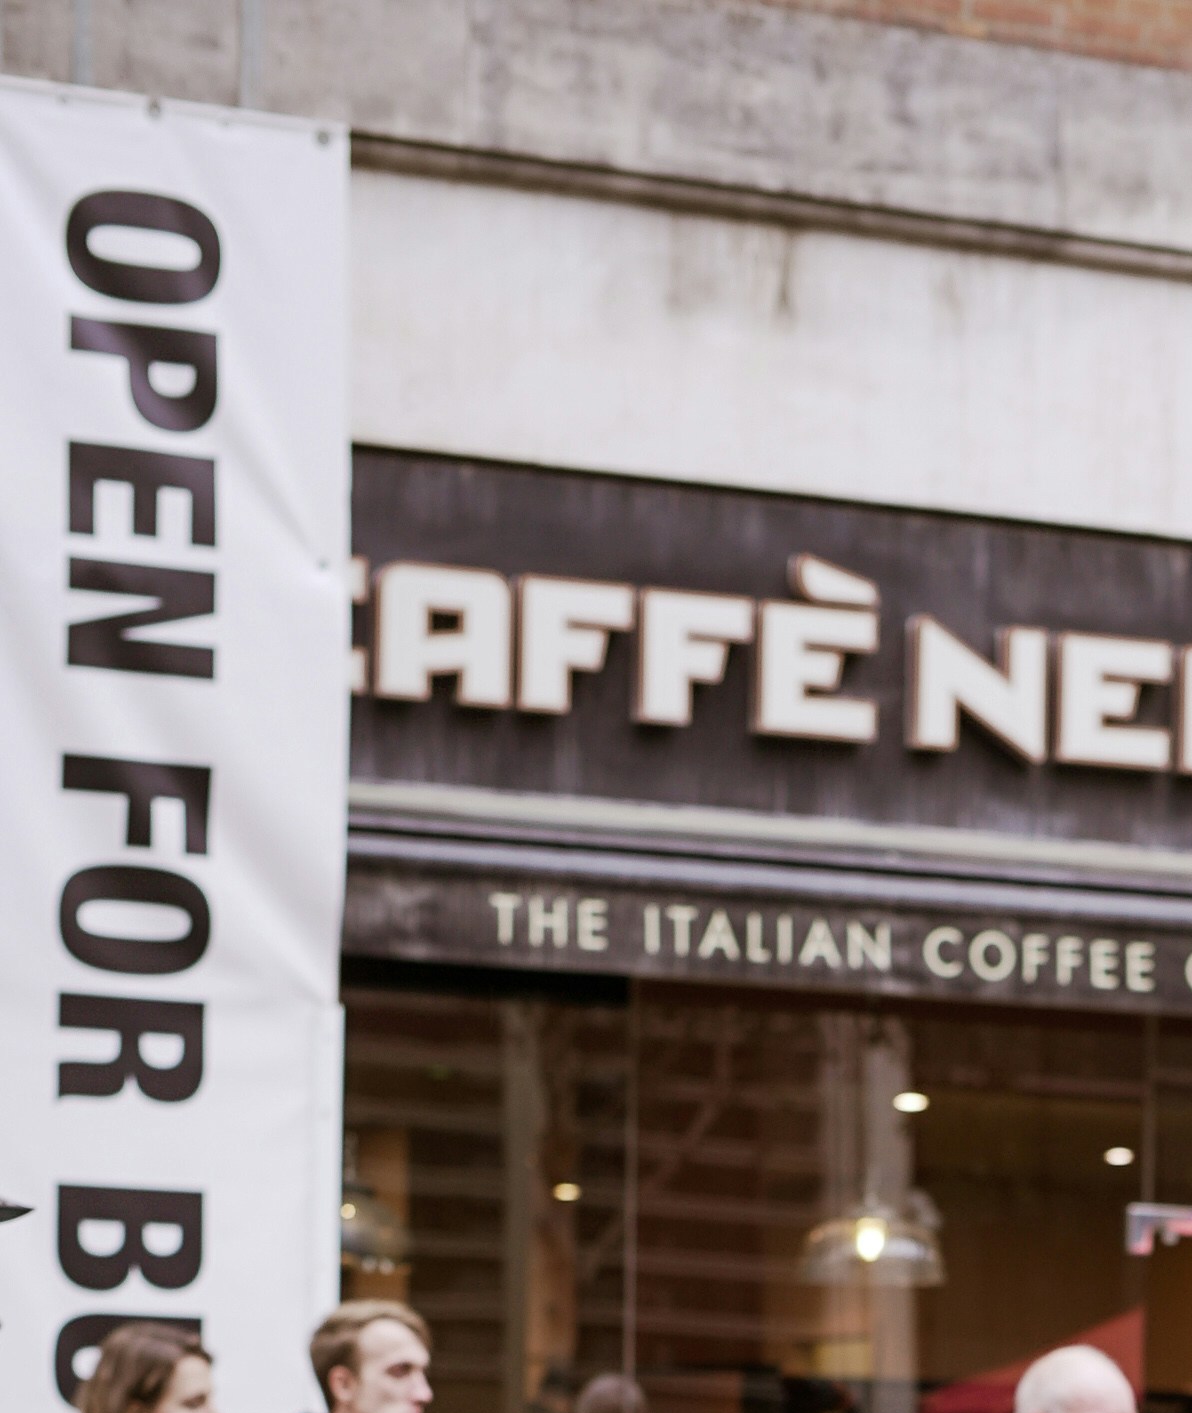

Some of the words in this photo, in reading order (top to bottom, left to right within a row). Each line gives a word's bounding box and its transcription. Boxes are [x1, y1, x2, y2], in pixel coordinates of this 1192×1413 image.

[65, 189, 221, 680] OPEN
[350, 554, 879, 744] AFFÈ
[57, 752, 213, 1104] FOR
[487, 892, 610, 952] THE
[643, 903, 893, 972] ITALIAN
[922, 926, 1156, 993] COFFEE
